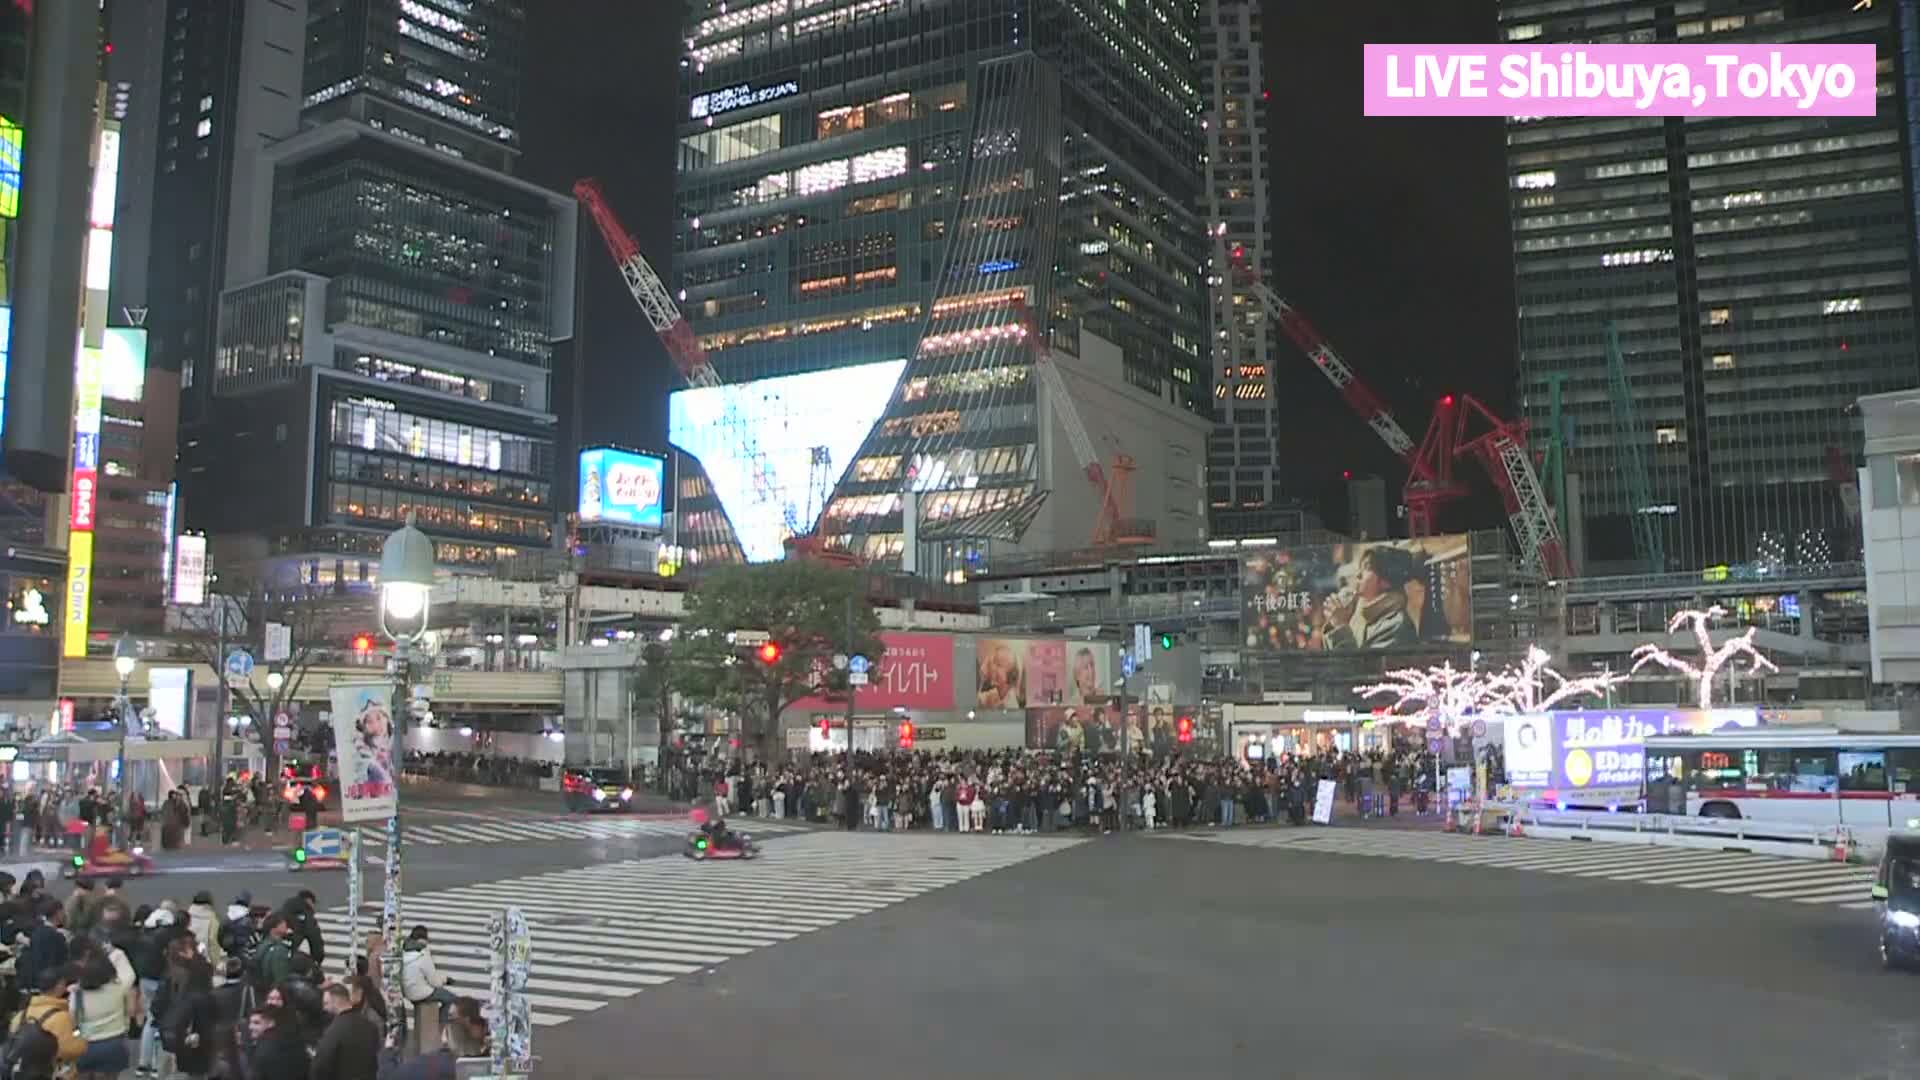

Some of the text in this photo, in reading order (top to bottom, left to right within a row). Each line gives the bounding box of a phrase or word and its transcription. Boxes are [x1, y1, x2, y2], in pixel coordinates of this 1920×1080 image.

[758, 81, 798, 102] SQUARE
[1253, 591, 1313, 613] 午後の紅茶
